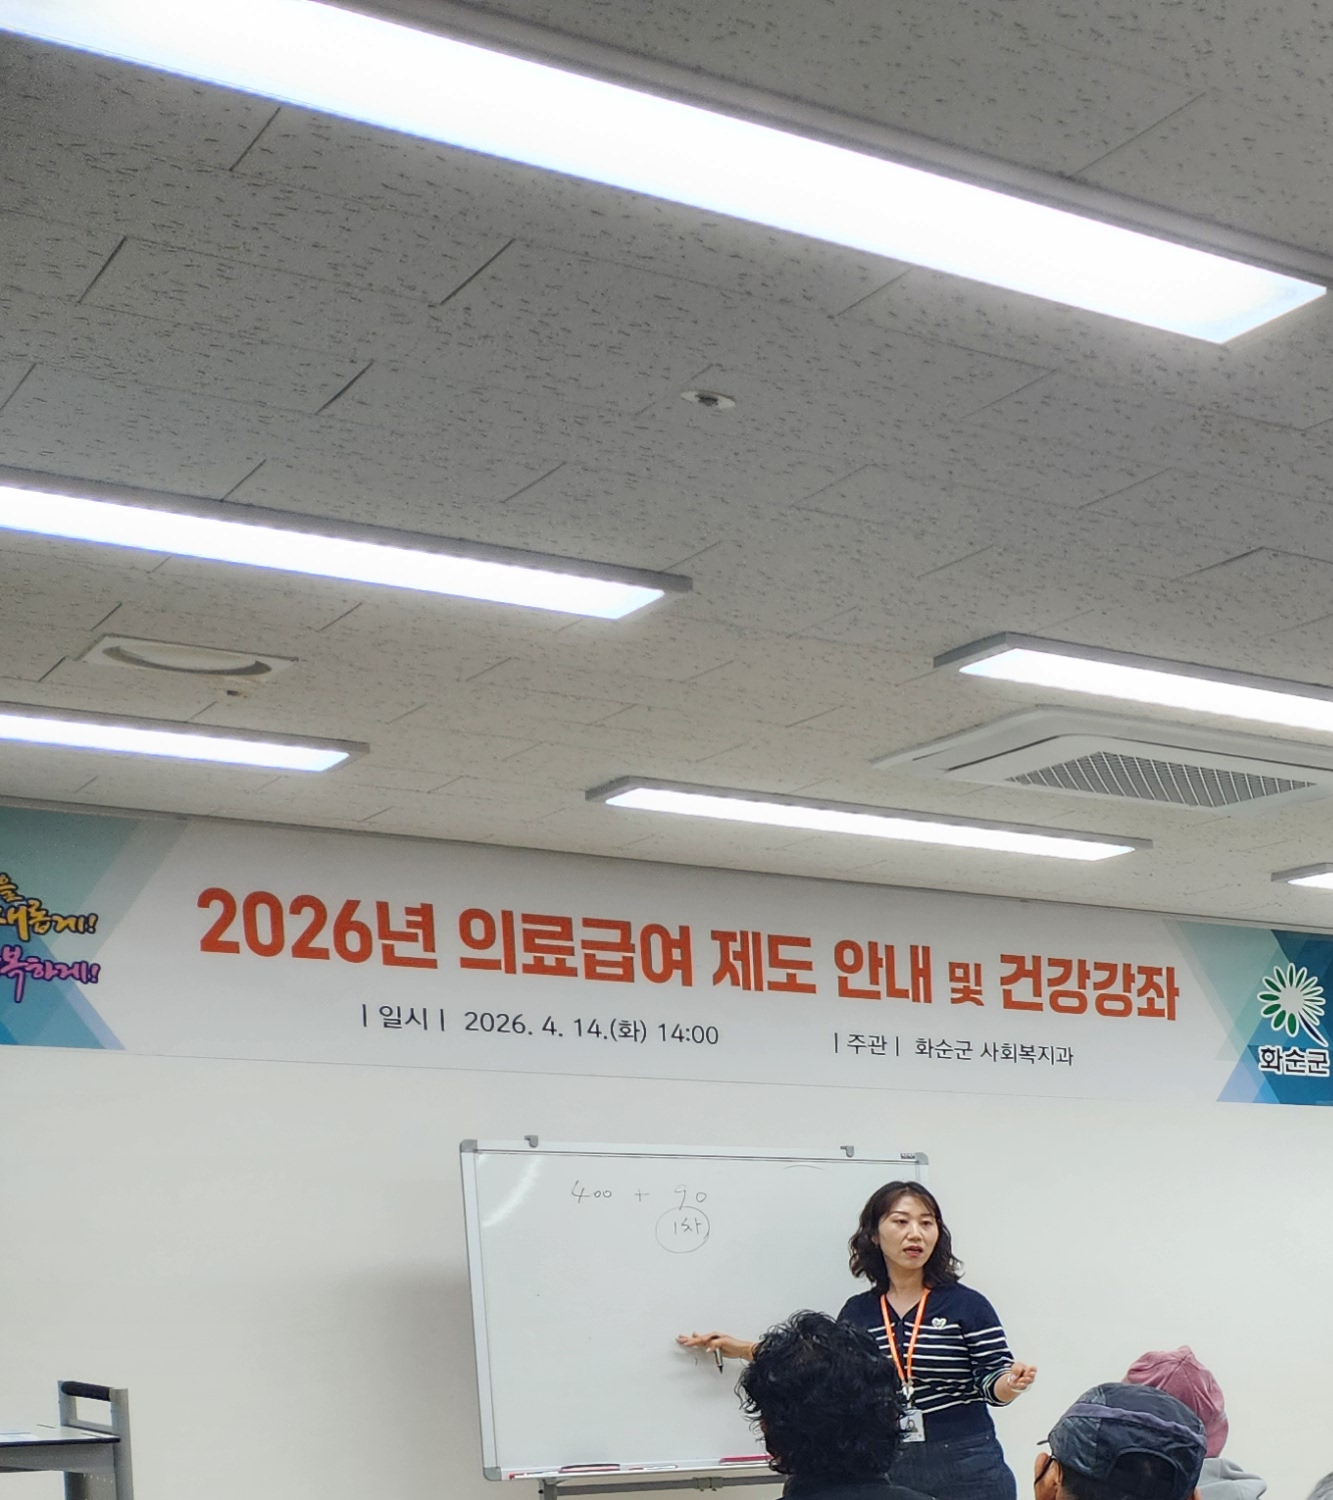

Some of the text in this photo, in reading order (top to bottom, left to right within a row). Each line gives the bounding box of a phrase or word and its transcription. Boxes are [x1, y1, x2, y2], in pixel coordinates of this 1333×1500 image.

[197, 887, 1179, 1021] 2026년 의료급여 제도 안내 및 건강강좌
[0, 944, 101, 1003] 복하게!
[463, 1011, 534, 1036] 2026.
[541, 1016, 564, 1038] 4.
[658, 1023, 719, 1046] 14:00
[915, 1036, 973, 1061] 화순군
[980, 1041, 1074, 1067] 사회복지과
[1258, 1044, 1331, 1077] 화순군
[571, 1180, 612, 1203] 400
